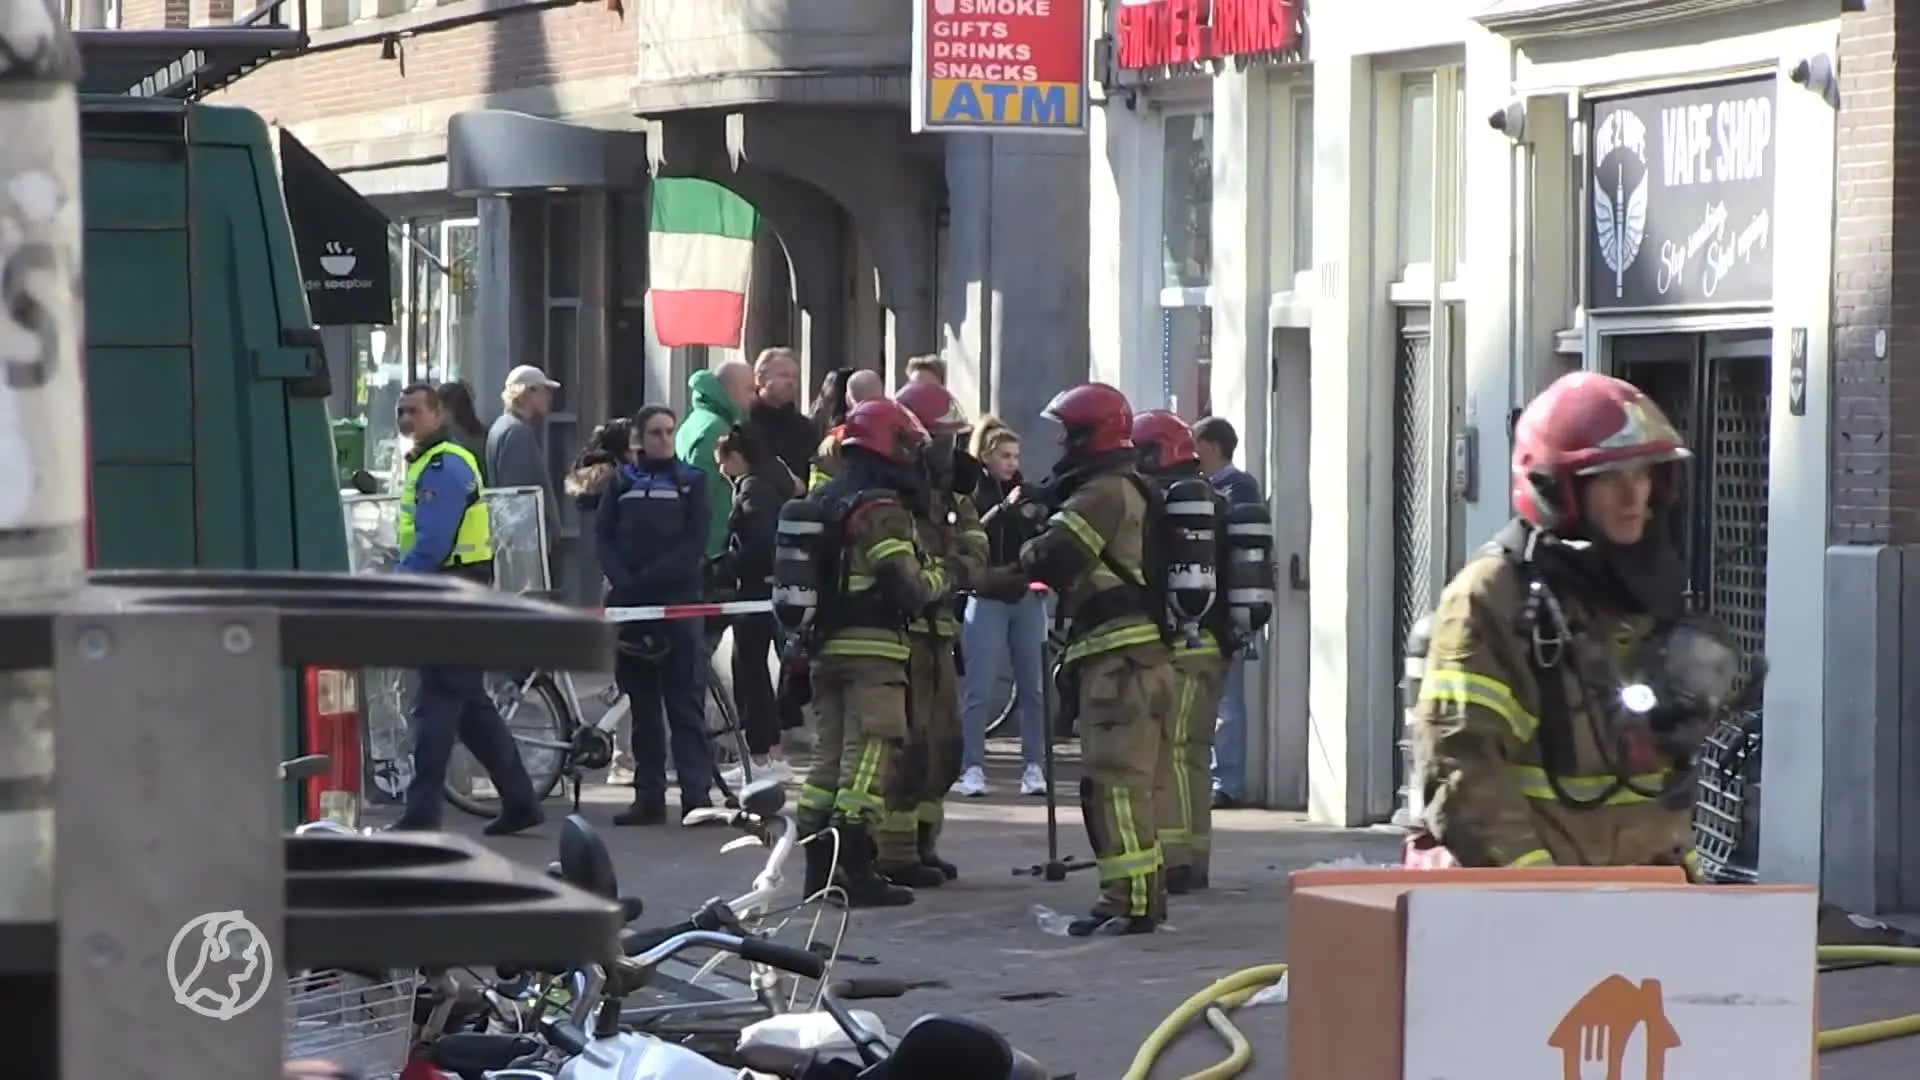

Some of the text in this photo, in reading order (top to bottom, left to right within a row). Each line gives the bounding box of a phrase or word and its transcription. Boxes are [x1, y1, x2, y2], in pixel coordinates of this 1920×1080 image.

[959, 0, 1051, 16] SMOKE
[933, 21, 1009, 38] GIFTS
[1117, 0, 1183, 68] SMOKE
[1211, 0, 1286, 57] DRINKS
[933, 41, 1031, 60] DRINKS
[933, 62, 1038, 81] SNACKS
[943, 82, 1066, 122] ATM
[1661, 103, 1713, 186] VAPE
[1715, 97, 1771, 182] SHOP
